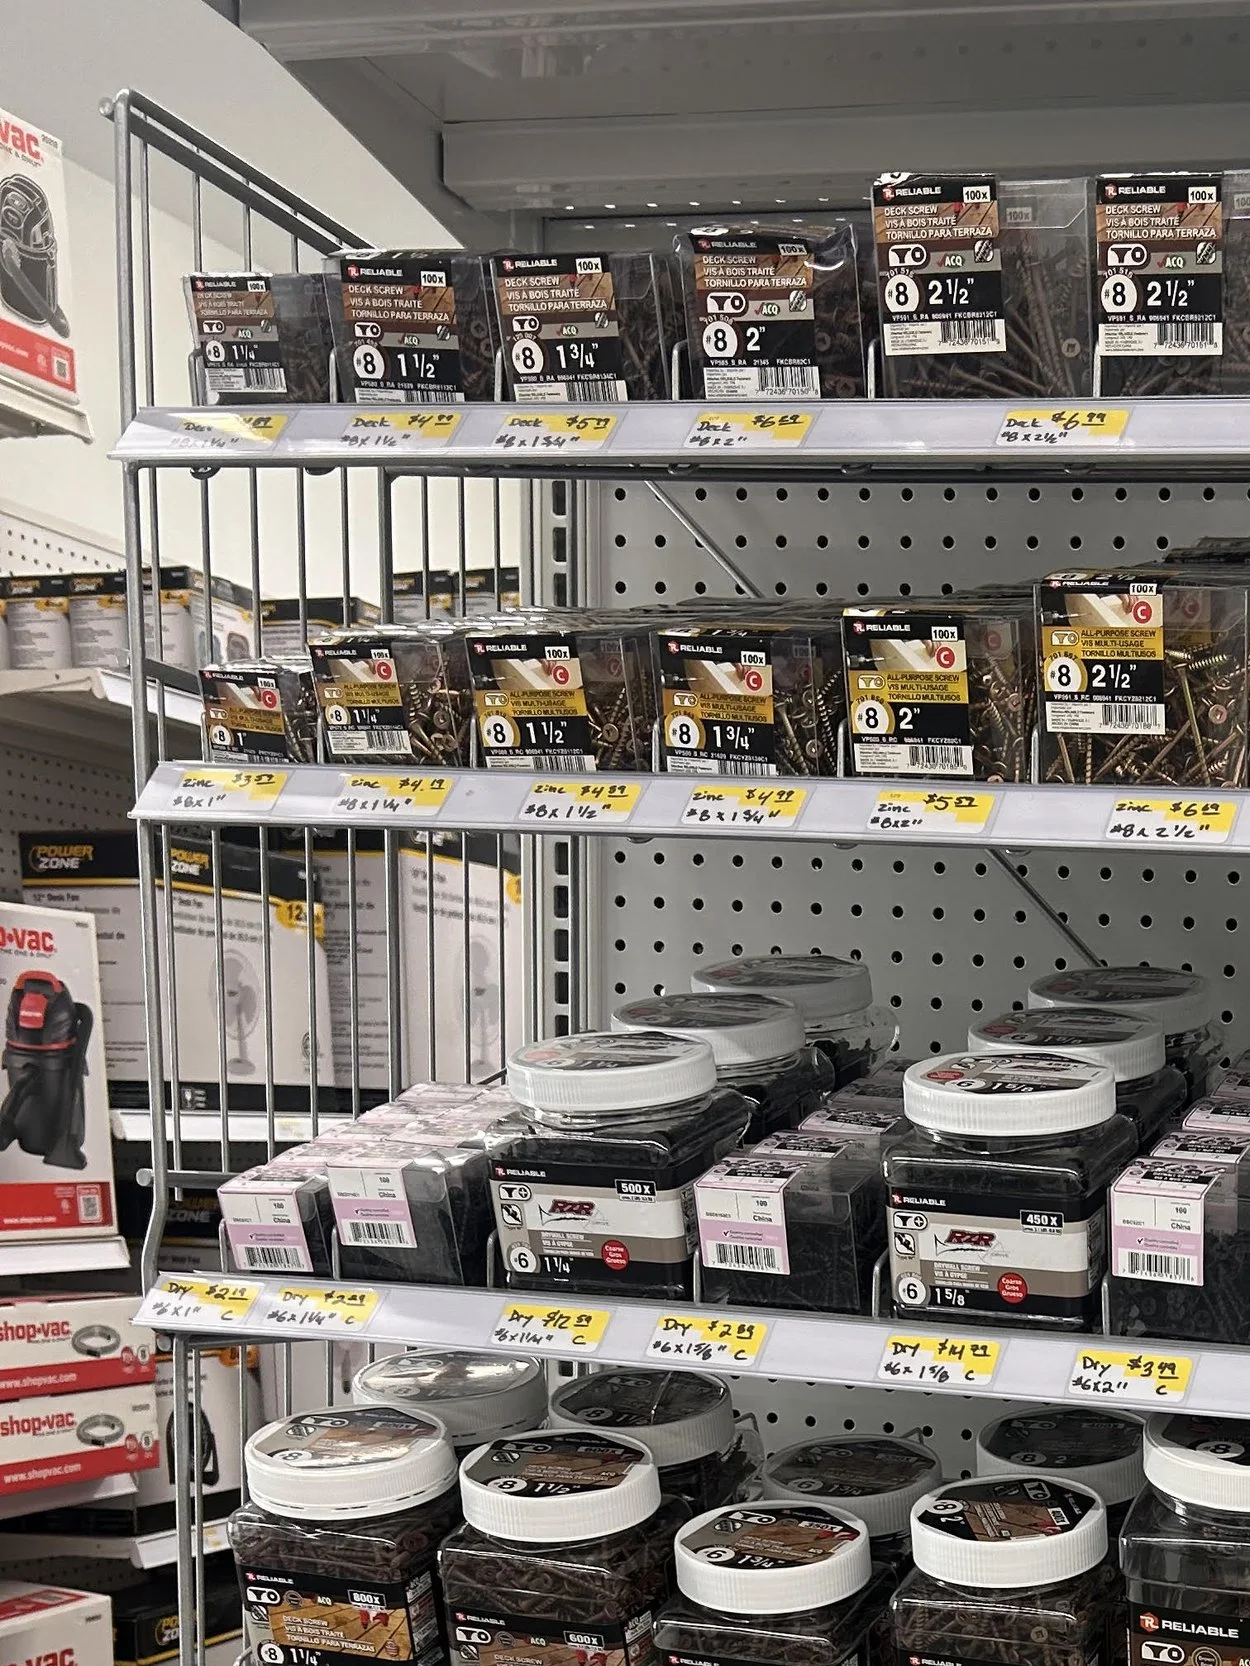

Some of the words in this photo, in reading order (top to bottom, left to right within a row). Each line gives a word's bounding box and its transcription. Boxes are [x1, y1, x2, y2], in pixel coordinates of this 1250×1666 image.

[895, 186, 942, 198] RELIABLE
[963, 189, 988, 202] 100x
[884, 206, 907, 217] DECK
[908, 204, 939, 216] SCREW
[1131, 584, 1155, 595] 100x
[1080, 629, 1129, 638] ALL-PURPOSE
[1129, 629, 1156, 639] SCREW
[36, 844, 96, 861] POWER
[39, 857, 81, 870] ZONE
[1083, 1356, 1111, 1373] Dry
[1160, 1619, 1240, 1640] RELIABLE
